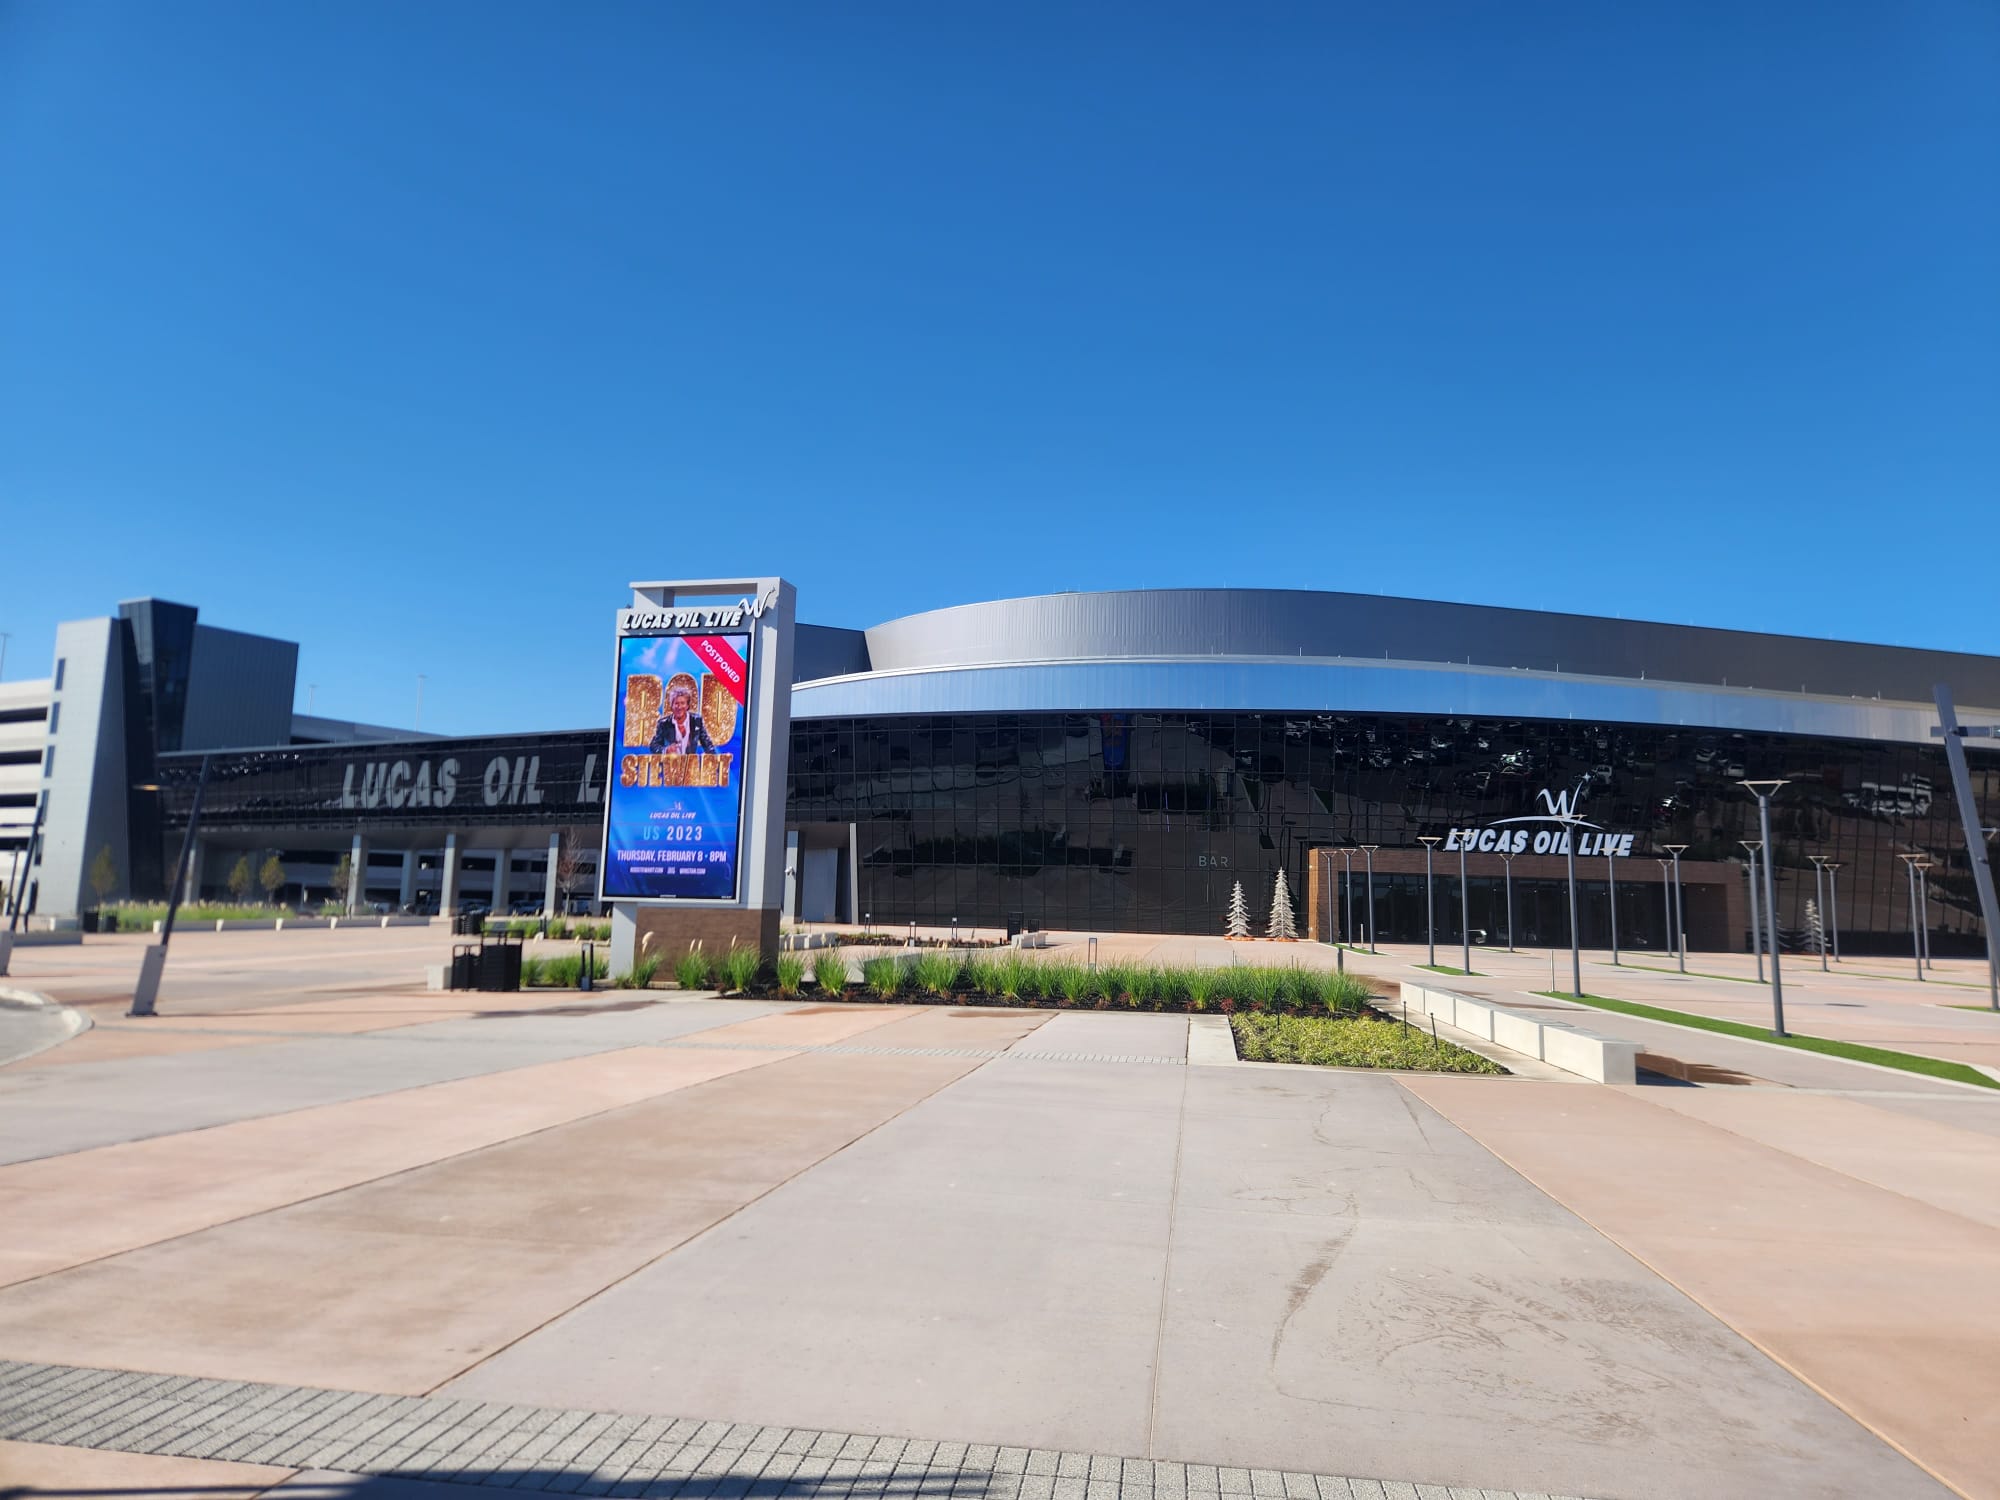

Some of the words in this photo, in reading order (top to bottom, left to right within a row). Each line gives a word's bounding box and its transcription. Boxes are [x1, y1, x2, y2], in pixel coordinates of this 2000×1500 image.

[621, 611, 673, 629] LUCAS
[674, 610, 701, 628] OIL
[704, 608, 744, 627] LIVE
[700, 639, 741, 683] POSTPONED
[620, 752, 734, 788] STEWART
[341, 758, 461, 809] LUCAS
[483, 755, 545, 807] OIL
[649, 812, 669, 820] LUCAS
[643, 825, 660, 841] US
[666, 825, 703, 841] 2023
[1444, 828, 1529, 854] LUCAS
[1533, 830, 1571, 855] OIL
[1578, 831, 1635, 857] LIVE
[617, 849, 656, 863] THURSDAY,
[657, 849, 696, 863] FEBRUARY
[697, 850, 703, 862] 8
[709, 850, 727, 862] 8PM
[1199, 855, 1228, 867] BAR
